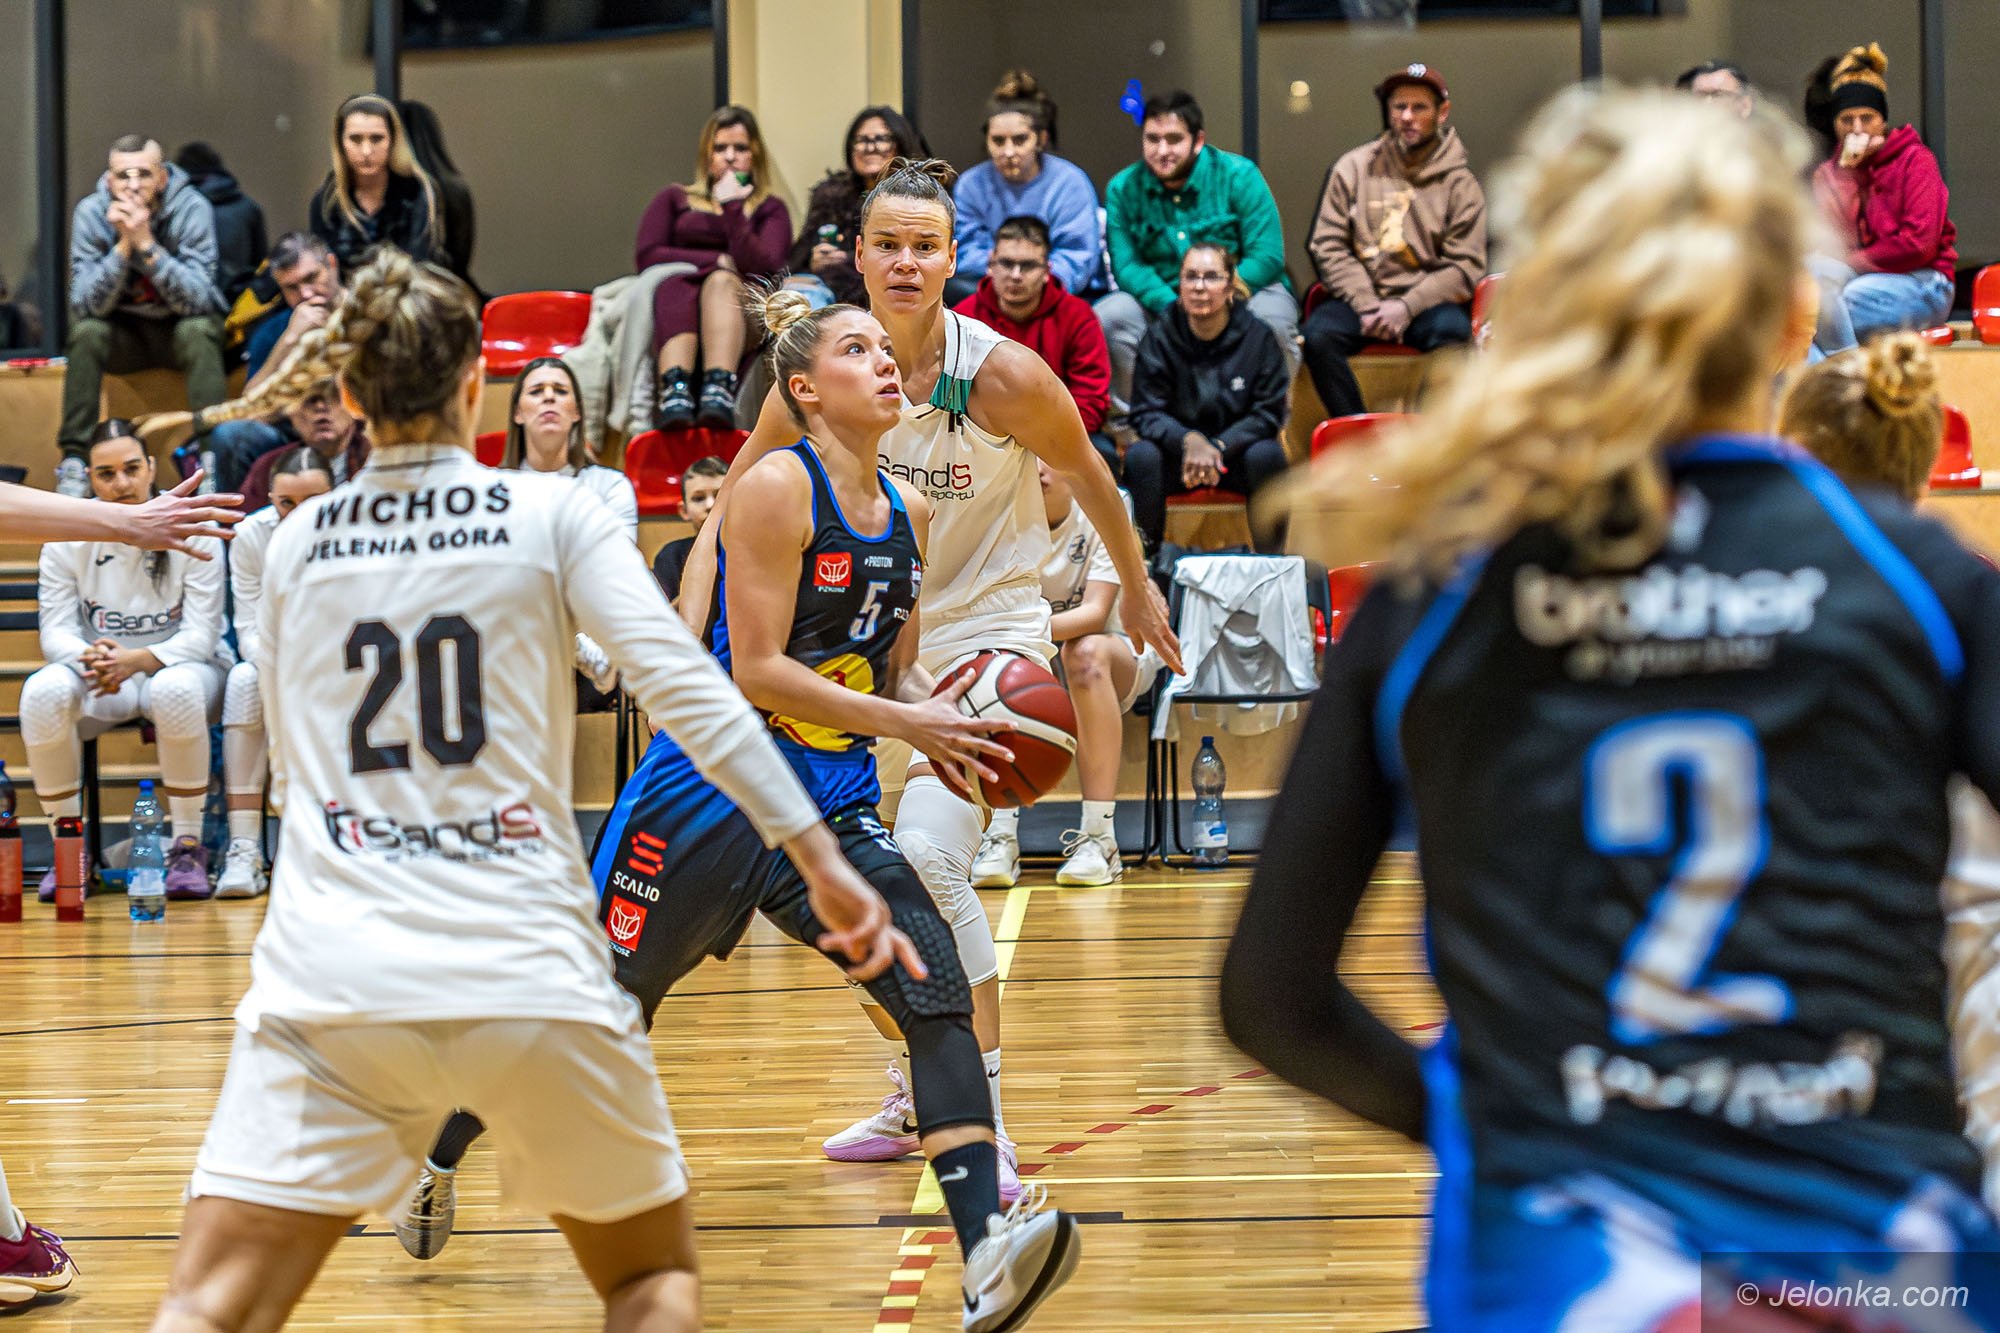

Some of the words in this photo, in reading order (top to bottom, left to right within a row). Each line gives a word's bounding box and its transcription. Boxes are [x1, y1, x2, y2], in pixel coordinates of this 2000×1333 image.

[315, 480, 511, 531] WICHOŚ
[306, 535, 417, 563] JELENIA
[428, 526, 510, 551] GÓRA
[847, 580, 891, 642] 5
[346, 615, 487, 773] 20
[612, 870, 661, 903] SCALIO
[1582, 709, 1797, 1046] 2
